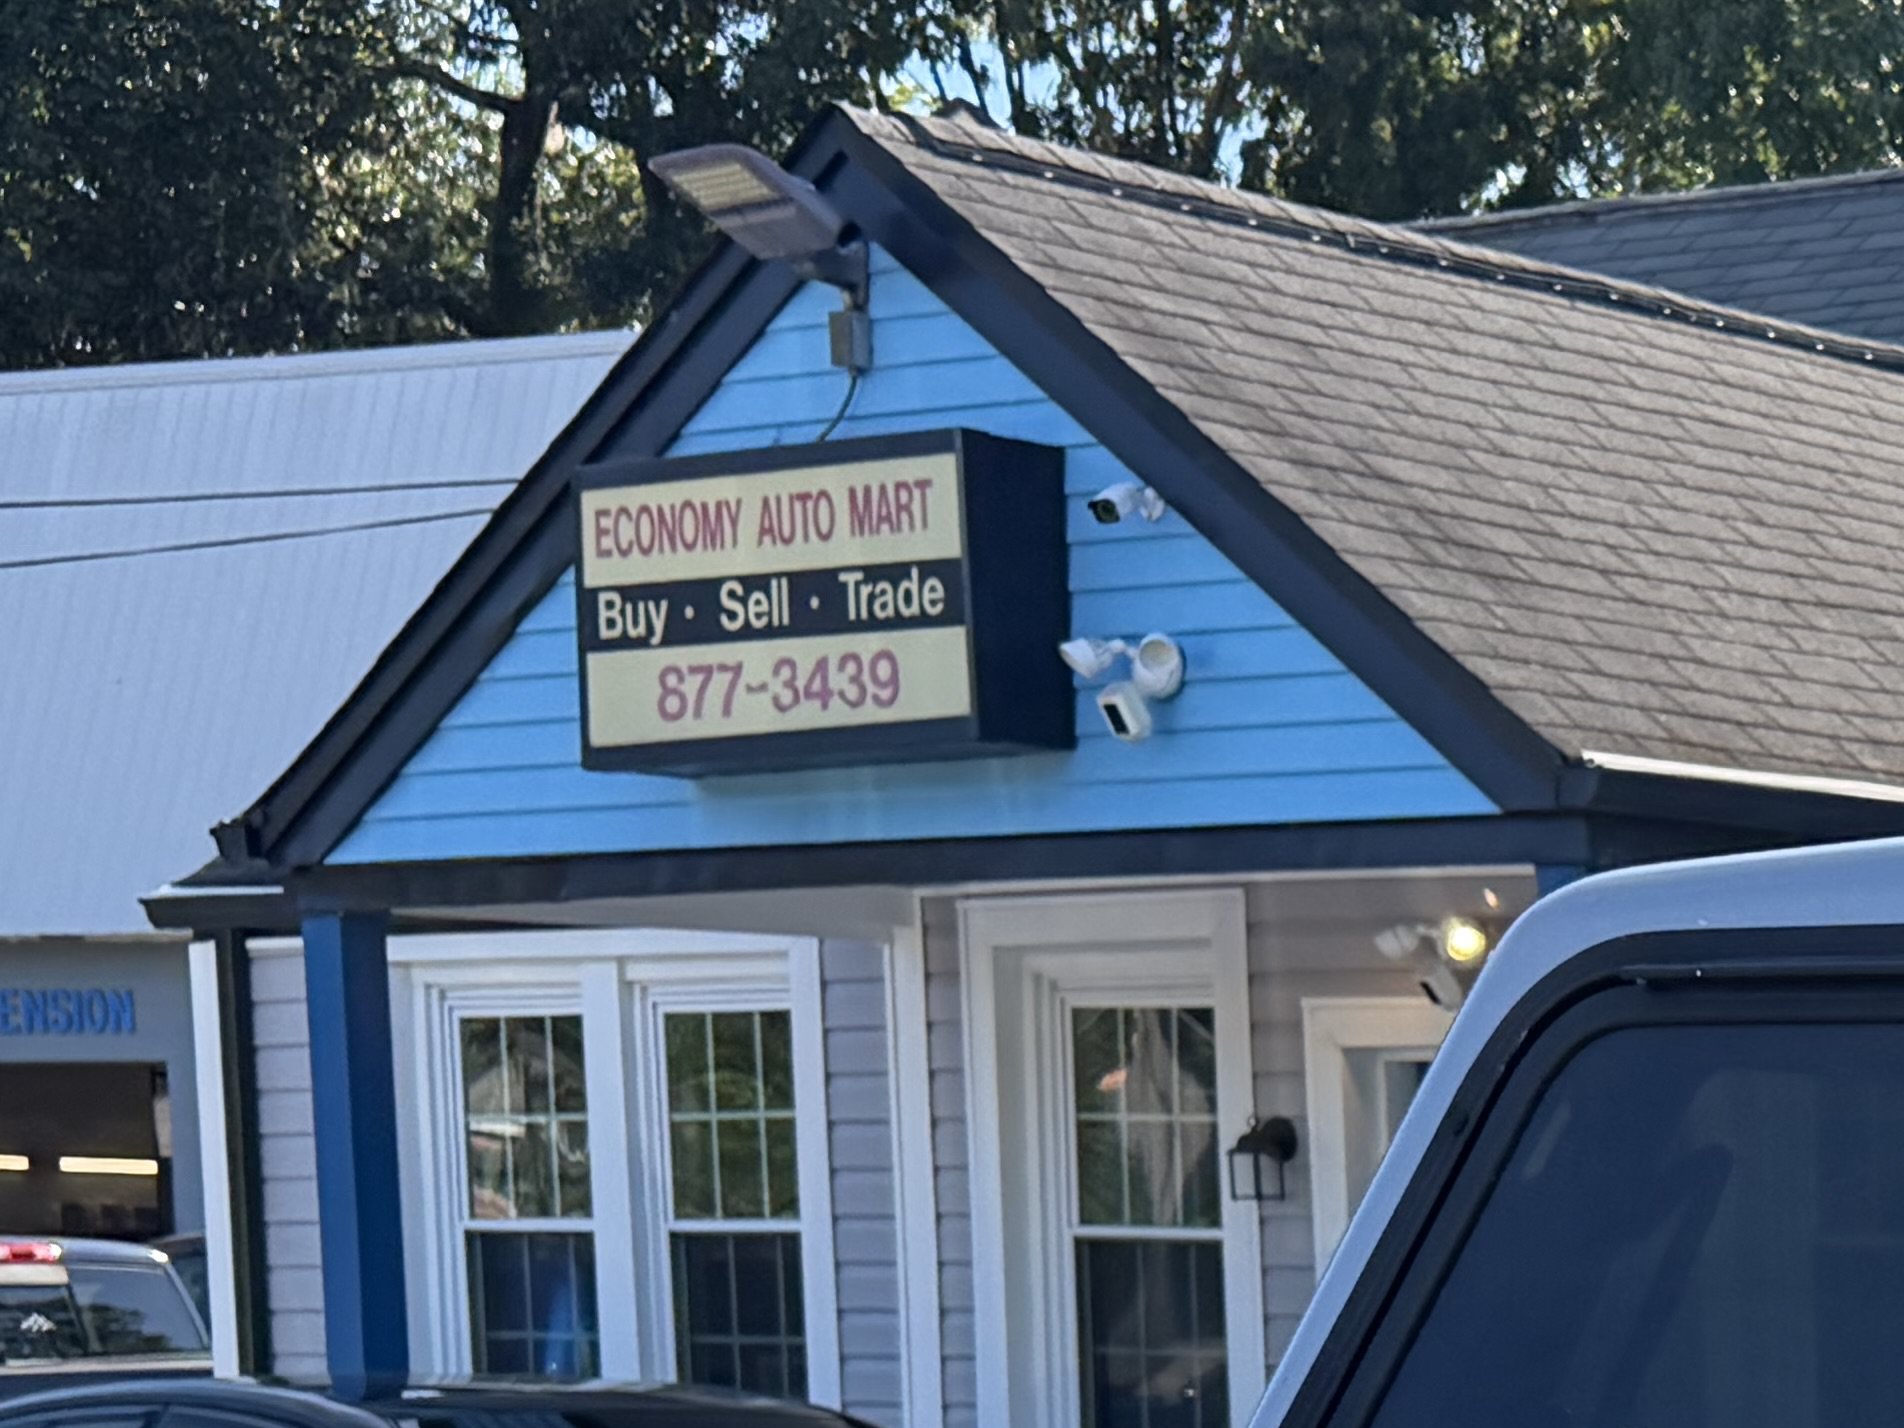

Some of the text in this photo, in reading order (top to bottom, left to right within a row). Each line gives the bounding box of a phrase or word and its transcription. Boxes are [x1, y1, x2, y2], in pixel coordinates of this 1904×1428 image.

[594, 479, 933, 559] ECONOMY AUTO MART
[598, 565, 945, 646] Buy Sell Trade
[656, 649, 900, 722] 877-3439
